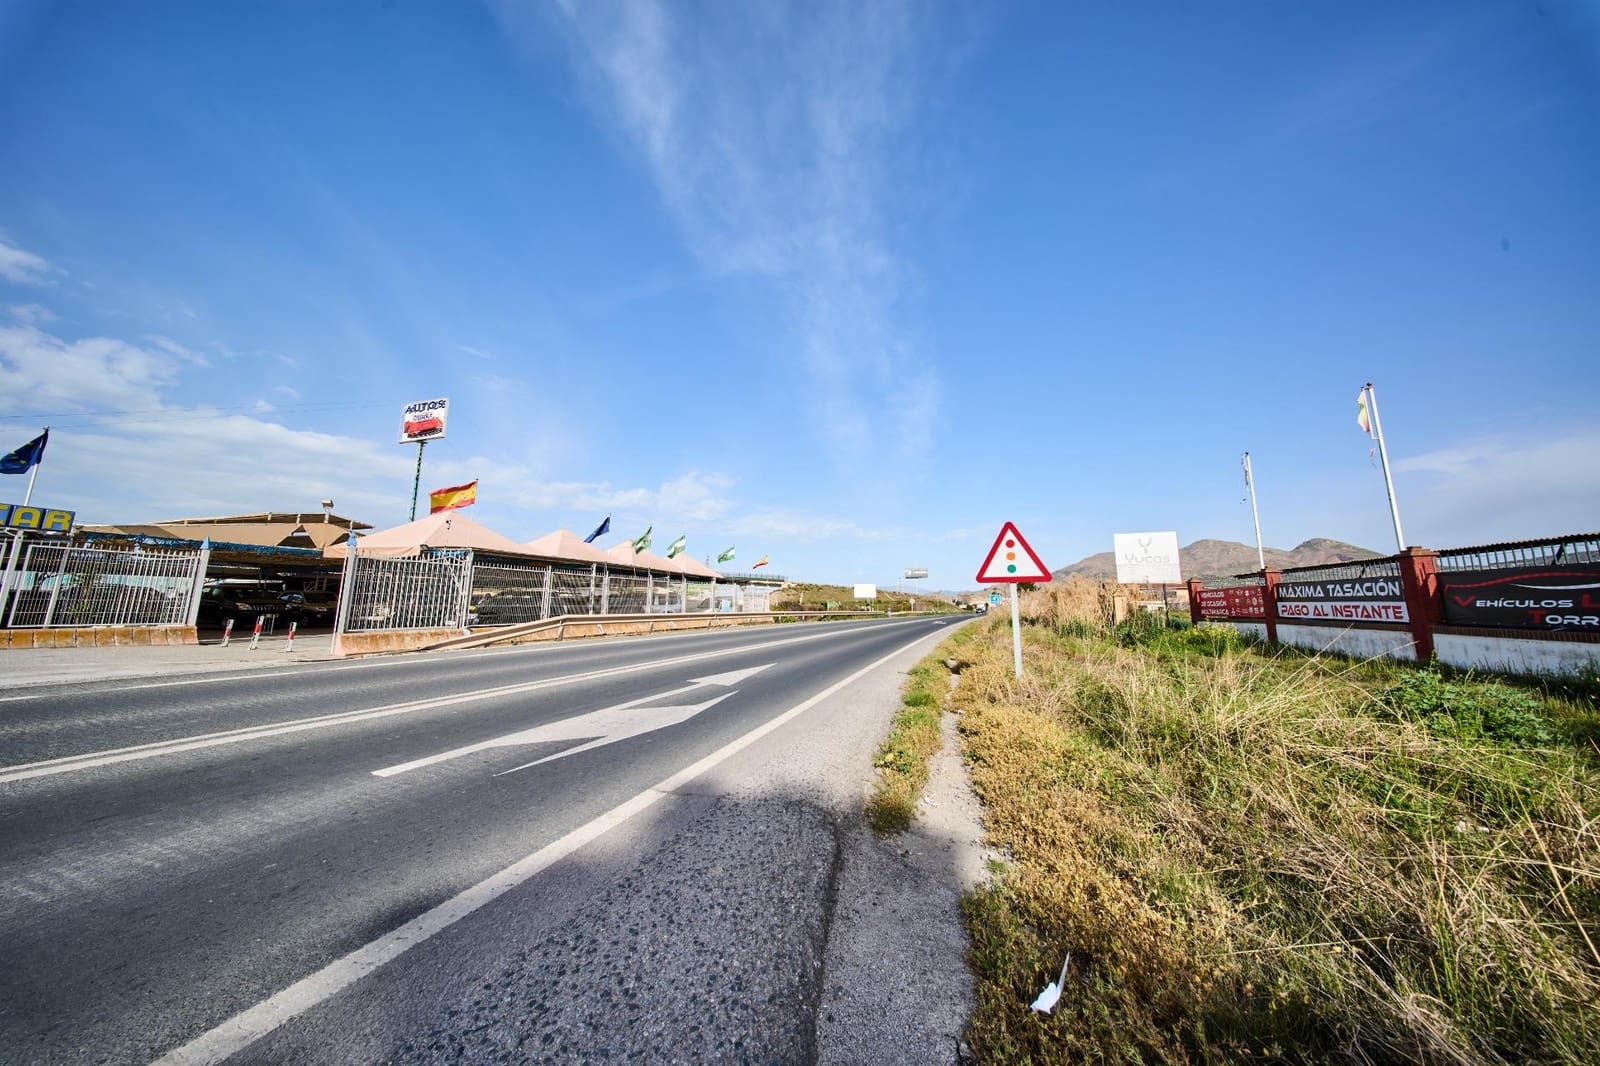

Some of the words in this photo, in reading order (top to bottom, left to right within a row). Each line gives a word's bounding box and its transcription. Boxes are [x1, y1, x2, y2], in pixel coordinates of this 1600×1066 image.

[1279, 583, 1324, 598] MÁXIMA
[1327, 578, 1400, 597] TASACIÓN
[1454, 595, 1574, 608] VEHÍCULOS
[1281, 604, 1309, 617] PAGO
[1312, 605, 1328, 617] AL
[1332, 605, 1404, 620] INSTANTE
